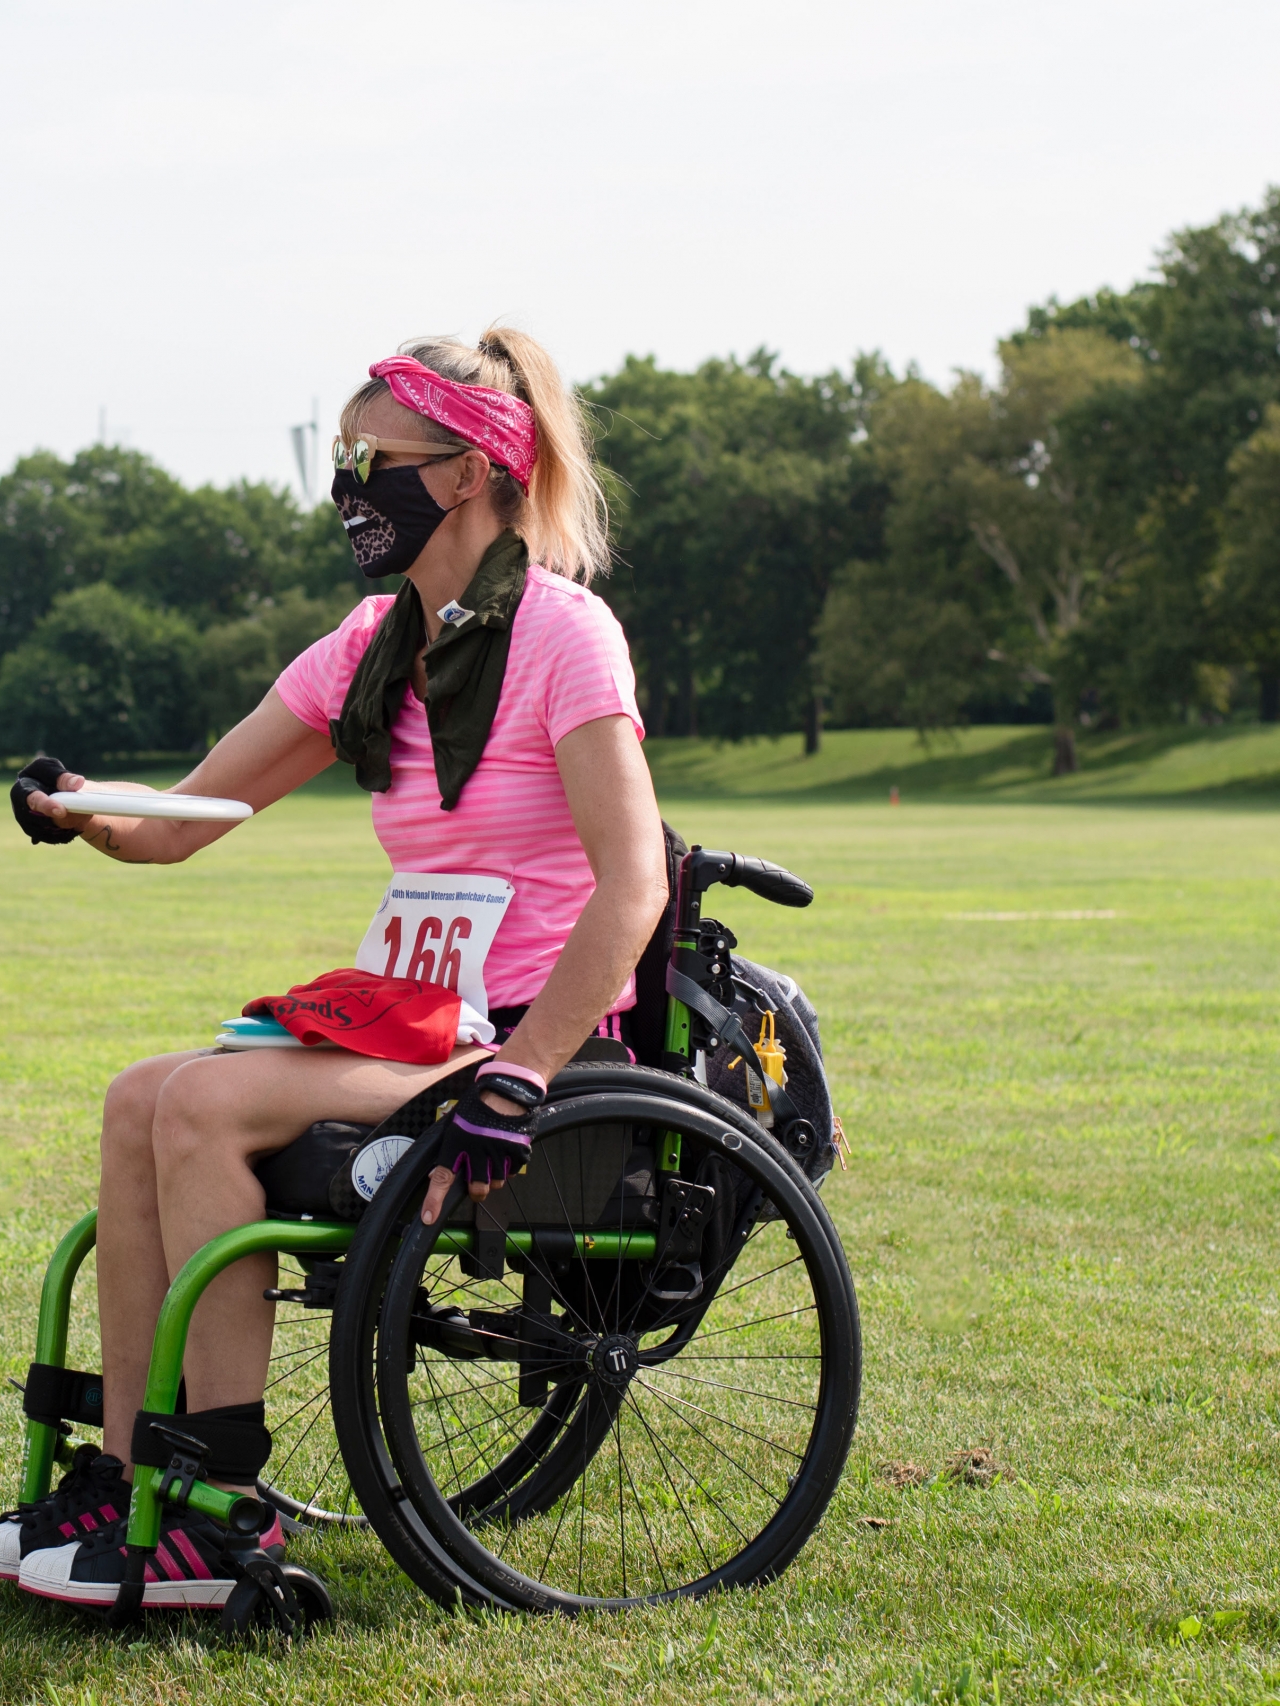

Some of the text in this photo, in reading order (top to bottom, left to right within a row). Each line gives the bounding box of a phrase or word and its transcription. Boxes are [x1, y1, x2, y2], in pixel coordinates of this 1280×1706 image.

[391, 889, 507, 904] 40th National Veterans Wheelchair Games
[383, 916, 473, 994] 166
[708, 1102, 815, 1202] SCHWALBE
[357, 1174, 375, 1197] MAN
[609, 1349, 627, 1371] Ti
[387, 1509, 462, 1597] MARATHO
[494, 1571, 549, 1603] SURGE
